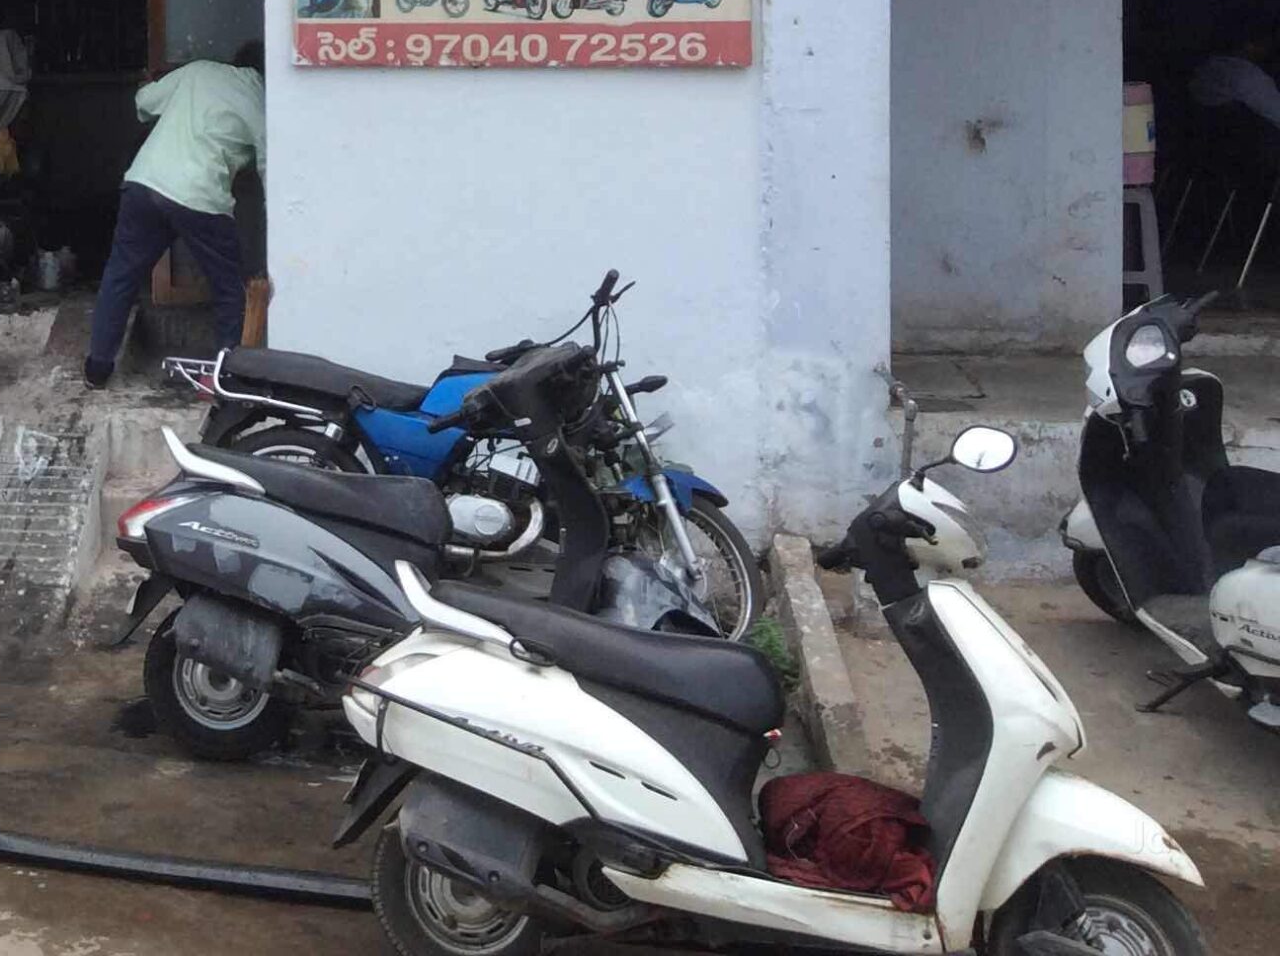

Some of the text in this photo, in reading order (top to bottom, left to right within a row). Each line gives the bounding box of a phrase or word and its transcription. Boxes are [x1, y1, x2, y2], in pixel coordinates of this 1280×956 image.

[317, 27, 377, 62] సెల్
[406, 34, 548, 62] 97040
[560, 33, 708, 62] 72526
